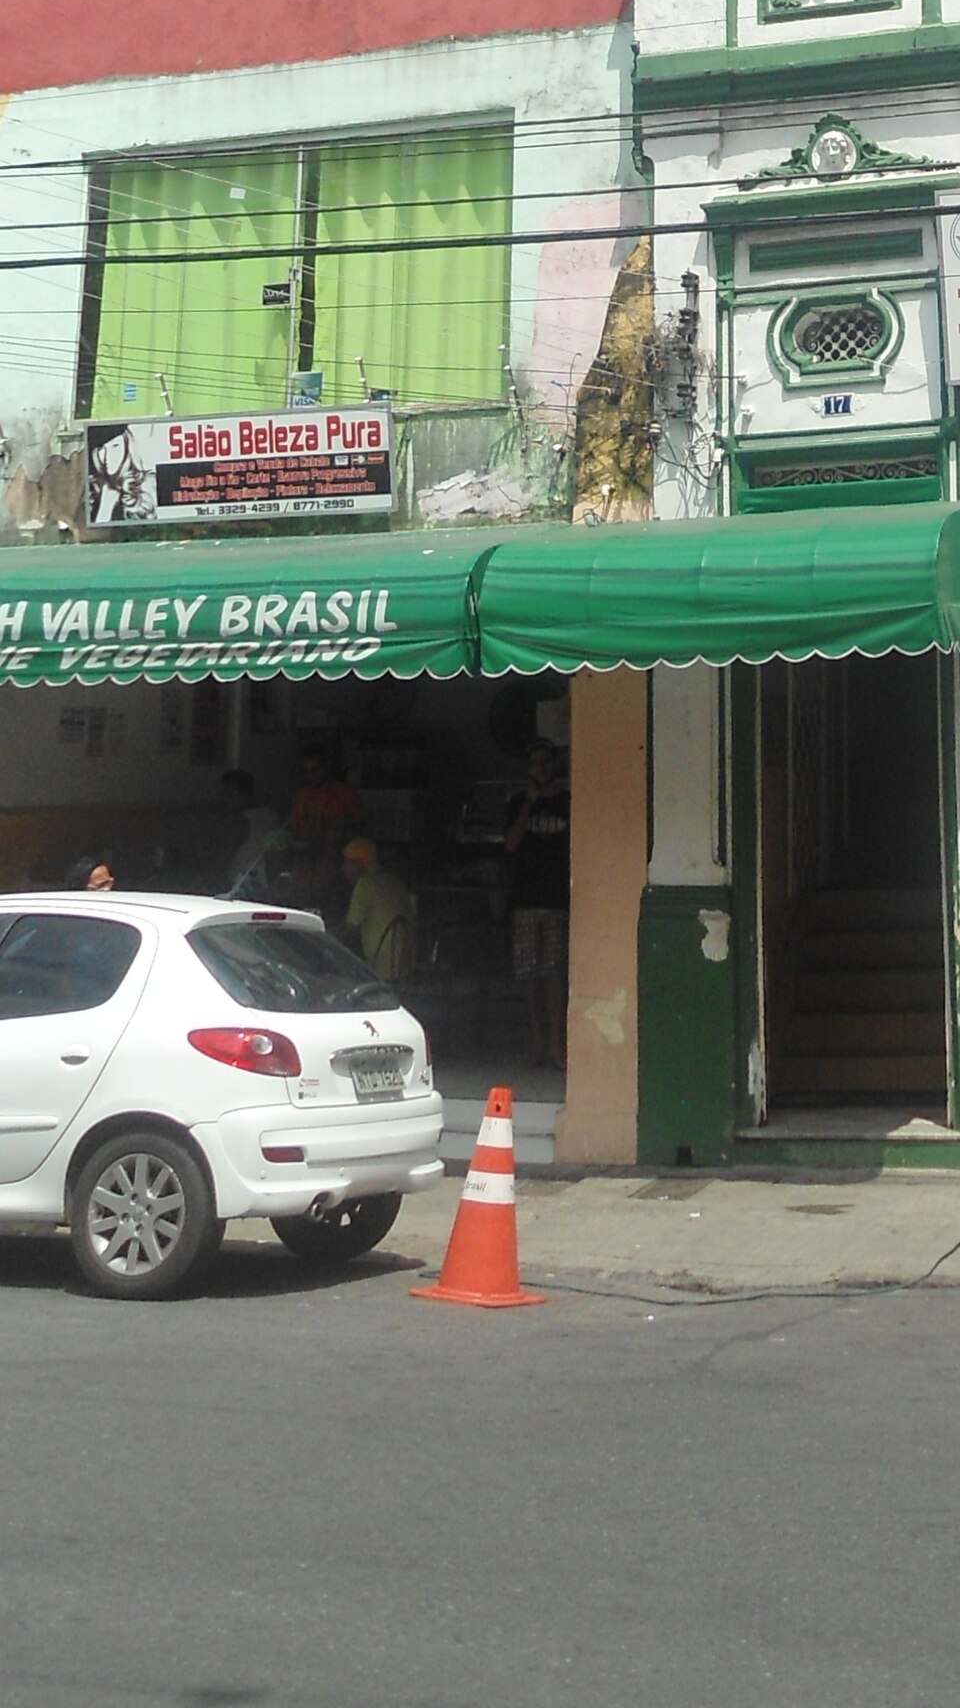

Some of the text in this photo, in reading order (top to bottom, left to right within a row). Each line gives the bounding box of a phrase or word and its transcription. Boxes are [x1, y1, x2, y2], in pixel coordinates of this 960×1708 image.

[829, 396, 845, 413] 17
[169, 415, 382, 459] Salão Beleza Pura
[218, 502, 280, 515] 3329-4239
[293, 498, 355, 511] 8771-2990
[42, 594, 208, 643] VALLEY
[219, 589, 398, 637] BRASIL
[59, 636, 382, 670] VEGETARIANO
